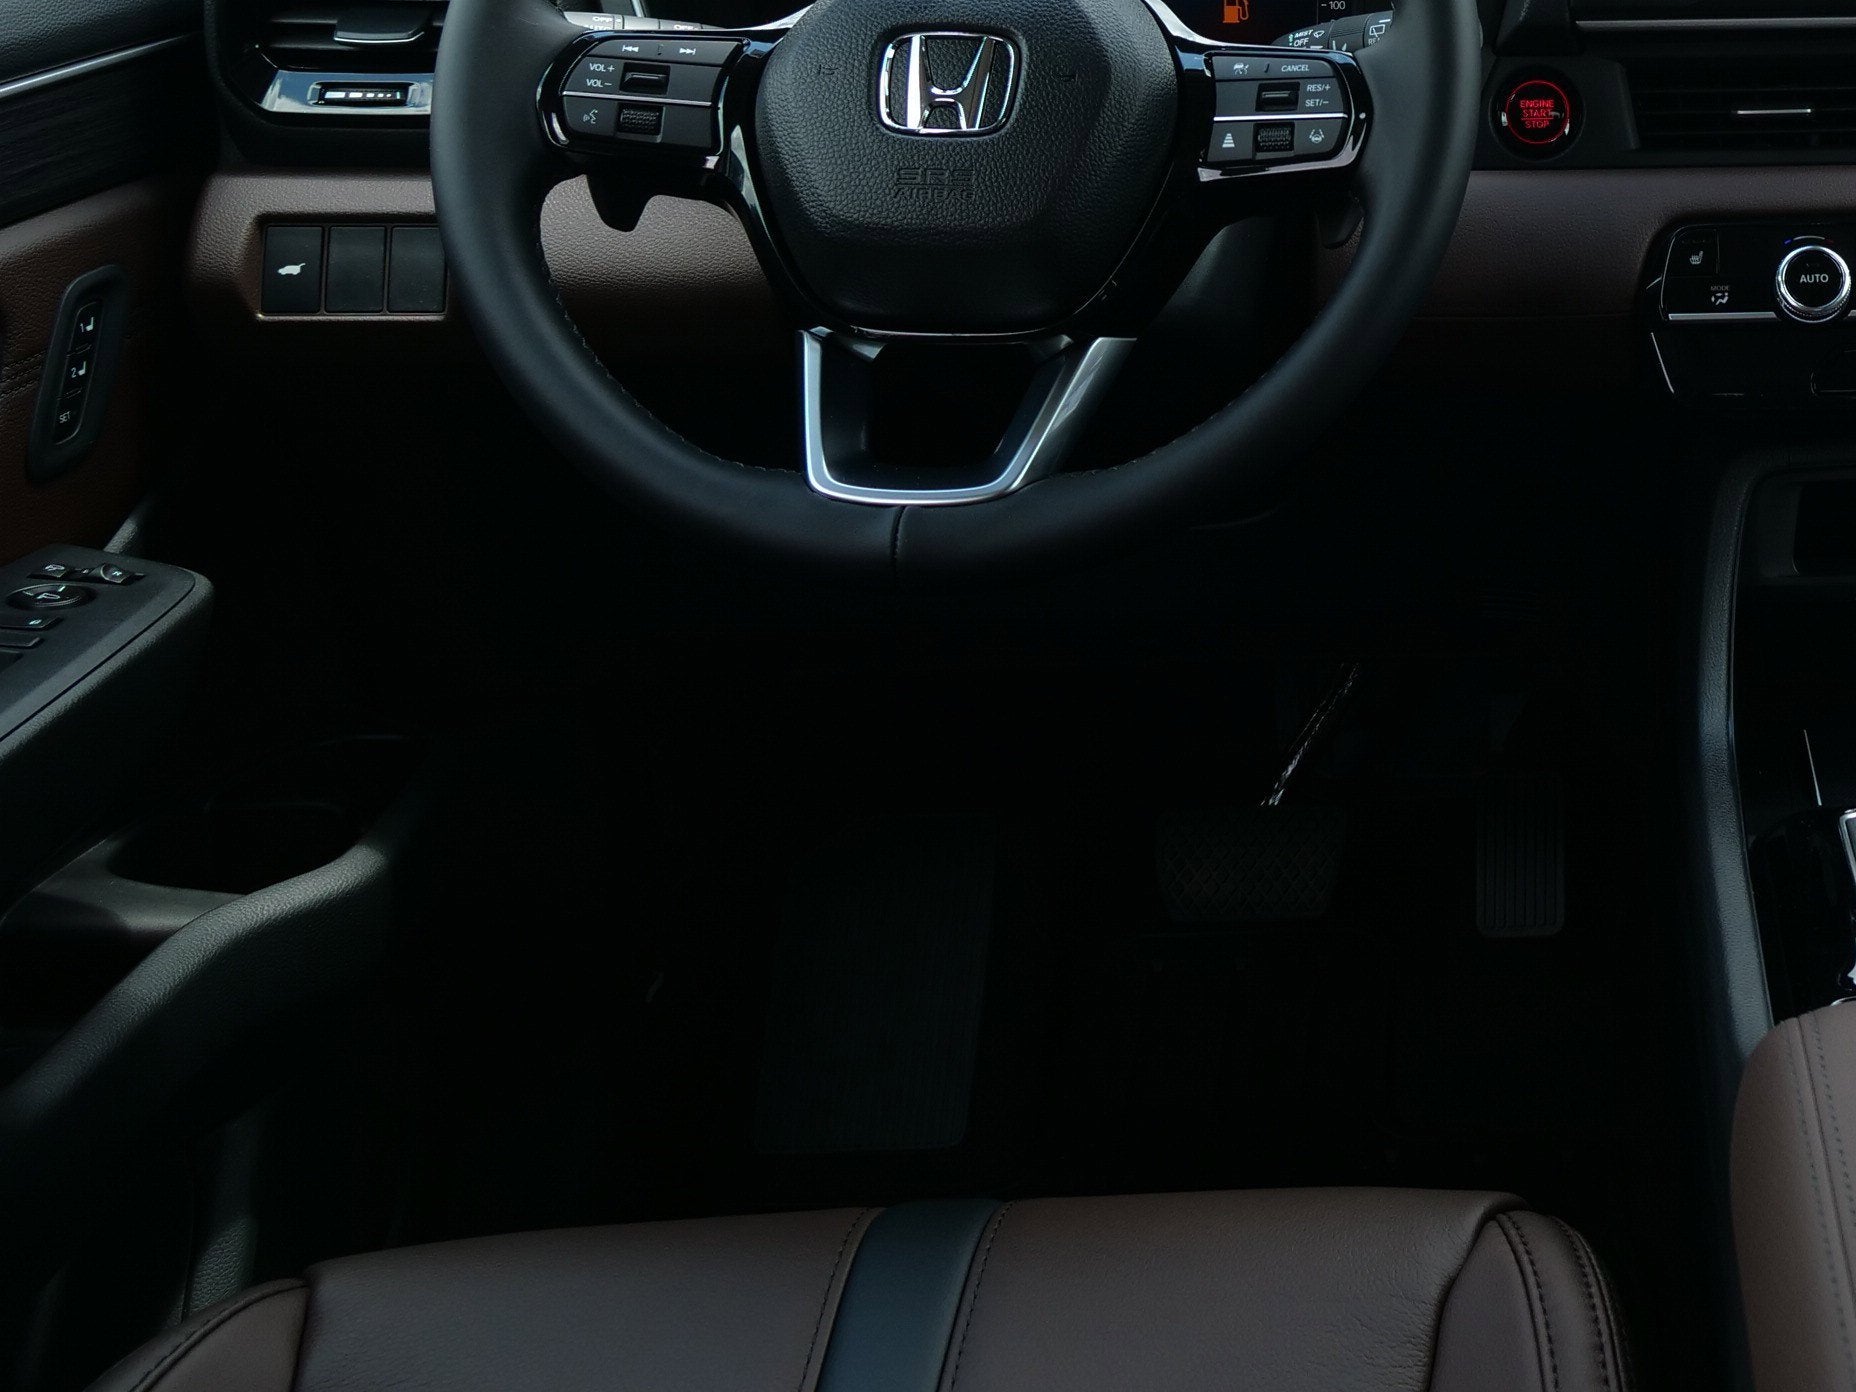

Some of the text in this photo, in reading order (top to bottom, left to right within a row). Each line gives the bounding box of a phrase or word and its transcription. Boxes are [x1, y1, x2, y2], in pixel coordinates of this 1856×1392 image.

[1328, 1, 1346, 10] 100
[1294, 38, 1309, 47] OFF
[1281, 64, 1309, 72] CANCEL
[1520, 100, 1554, 108] ENGINE
[1525, 120, 1549, 128] STOP
[1800, 274, 1829, 283] AUTO
[71, 367, 76, 378] 2
[60, 411, 71, 423] SET
